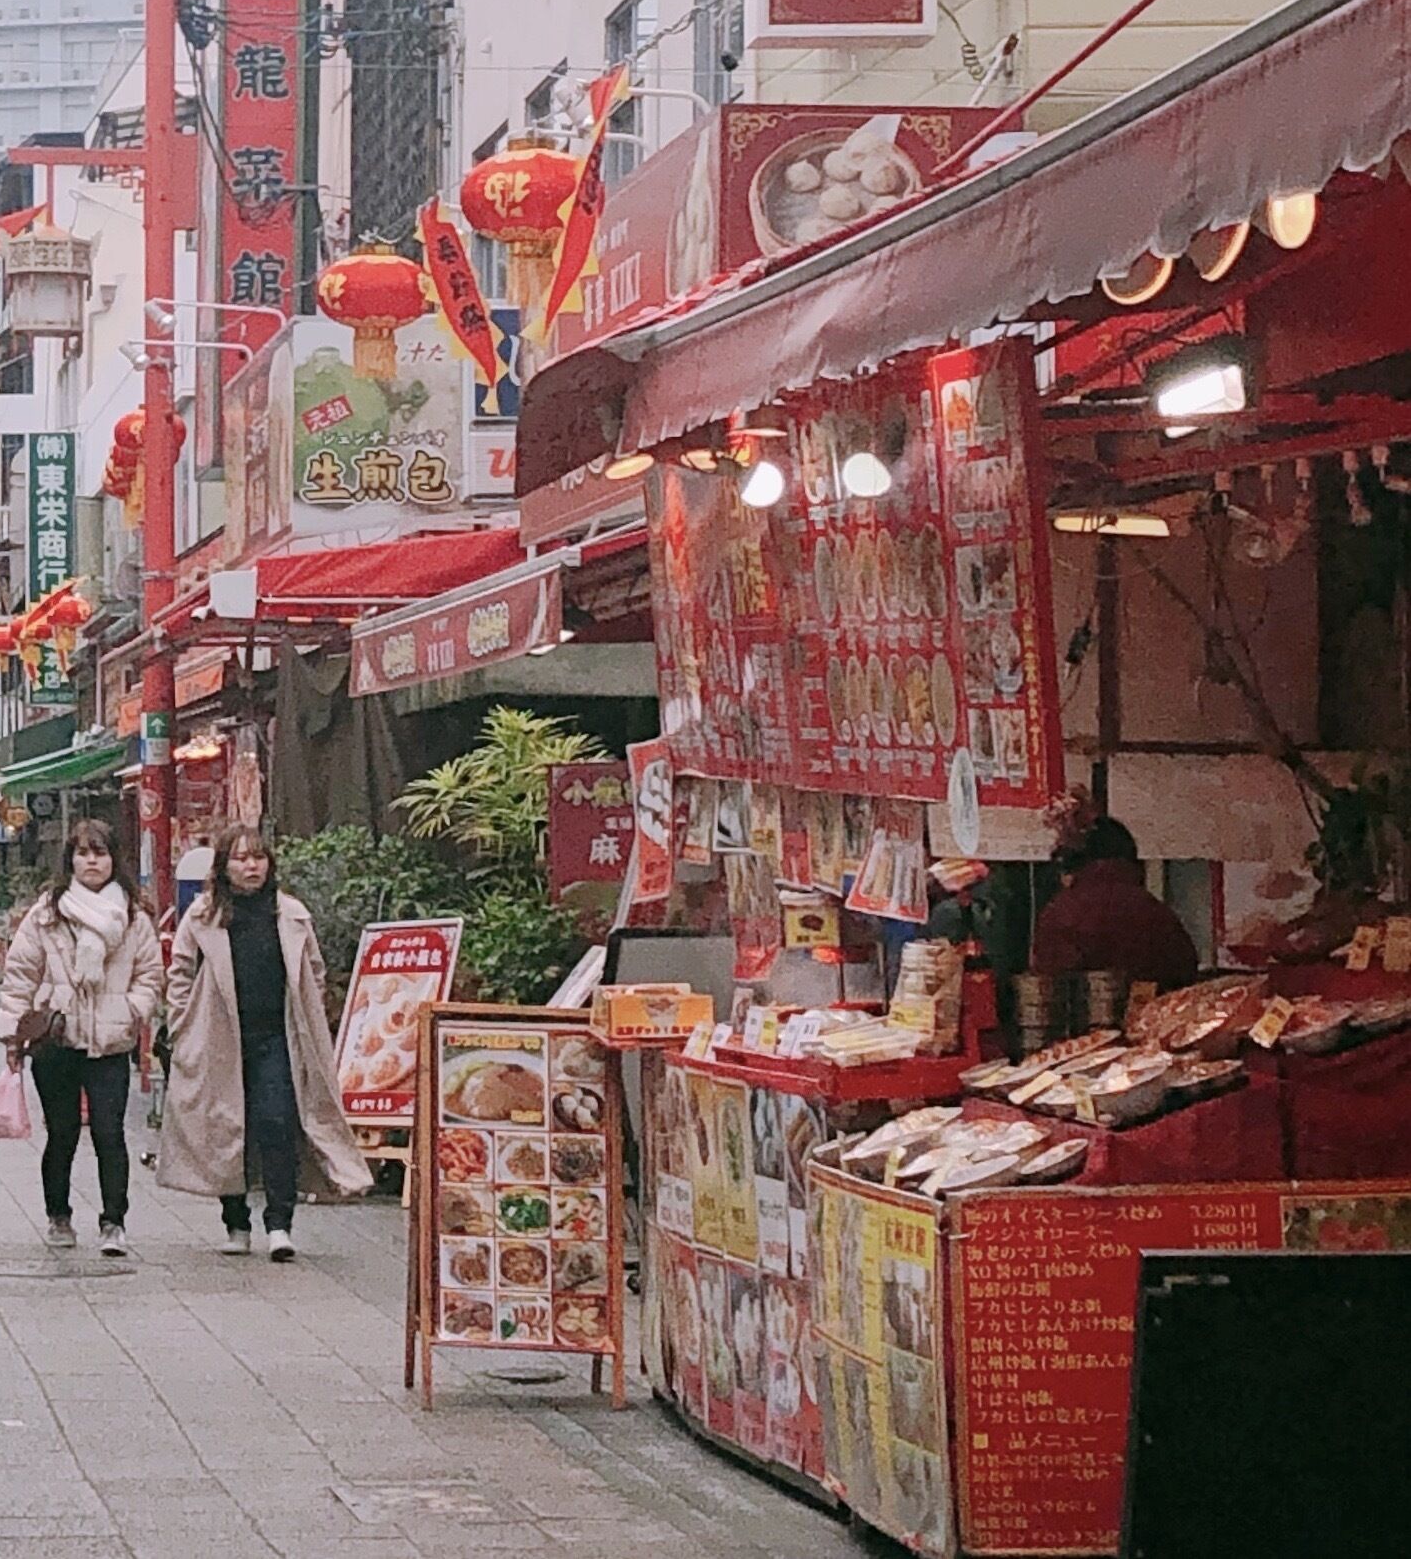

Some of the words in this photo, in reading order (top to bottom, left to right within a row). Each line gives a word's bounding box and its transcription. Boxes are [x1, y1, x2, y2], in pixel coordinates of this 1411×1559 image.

[307, 398, 352, 431] 元祖
[300, 445, 456, 505] 生煎包
